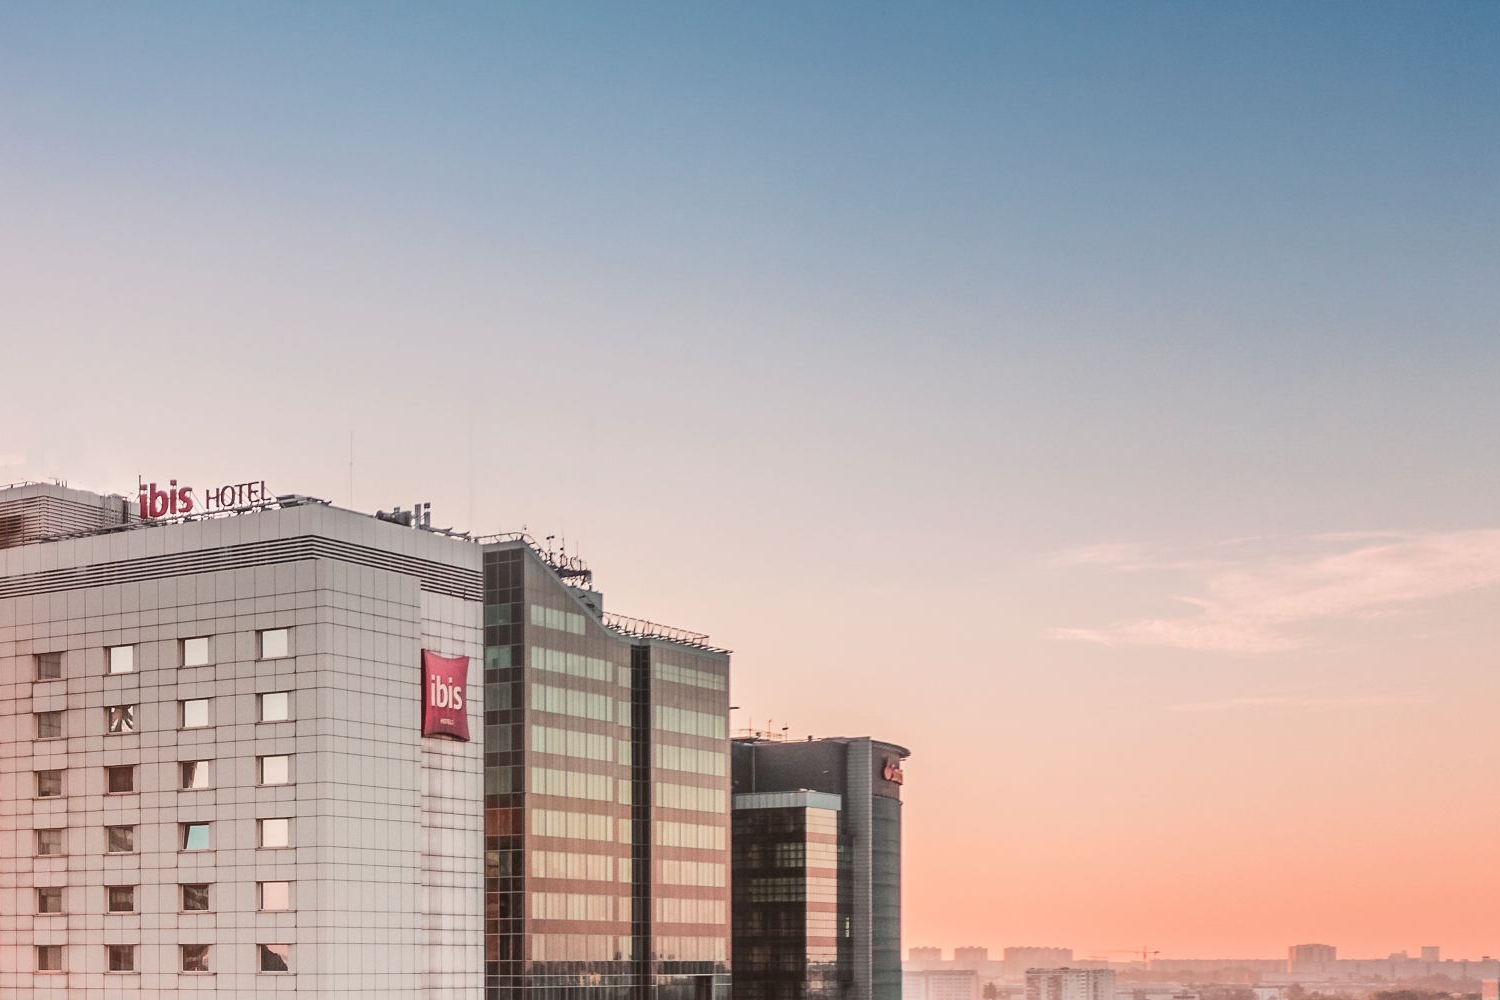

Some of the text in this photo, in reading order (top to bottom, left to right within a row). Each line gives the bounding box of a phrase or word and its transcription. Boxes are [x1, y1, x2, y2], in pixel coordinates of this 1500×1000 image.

[140, 479, 271, 518] ibis HOTEL
[430, 674, 463, 710] ibis
